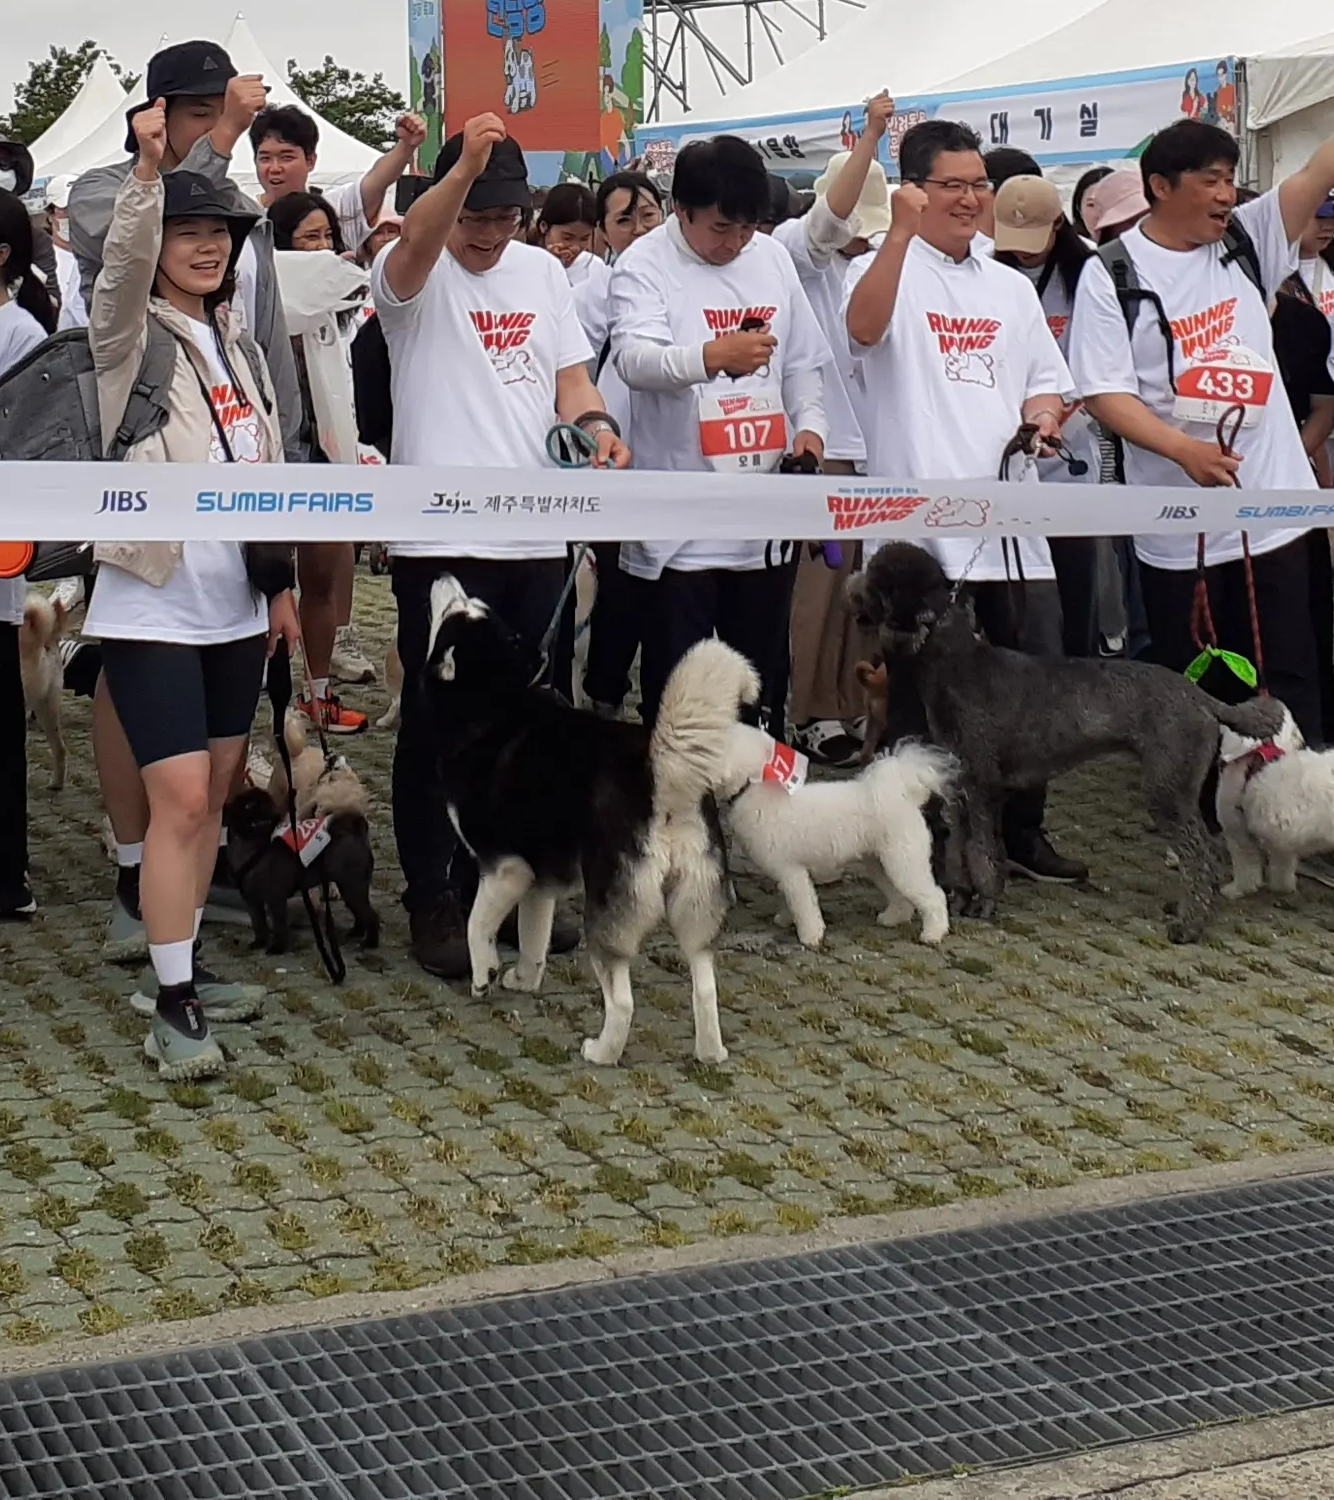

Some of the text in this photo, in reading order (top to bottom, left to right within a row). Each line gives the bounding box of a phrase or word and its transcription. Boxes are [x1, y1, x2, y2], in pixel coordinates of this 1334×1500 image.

[1196, 369, 1255, 400] 433
[723, 419, 773, 450] 107
[94, 490, 148, 515] JIBS
[429, 490, 602, 515] Jeju 제주특별자치도
[1156, 505, 1200, 520] JIBS
